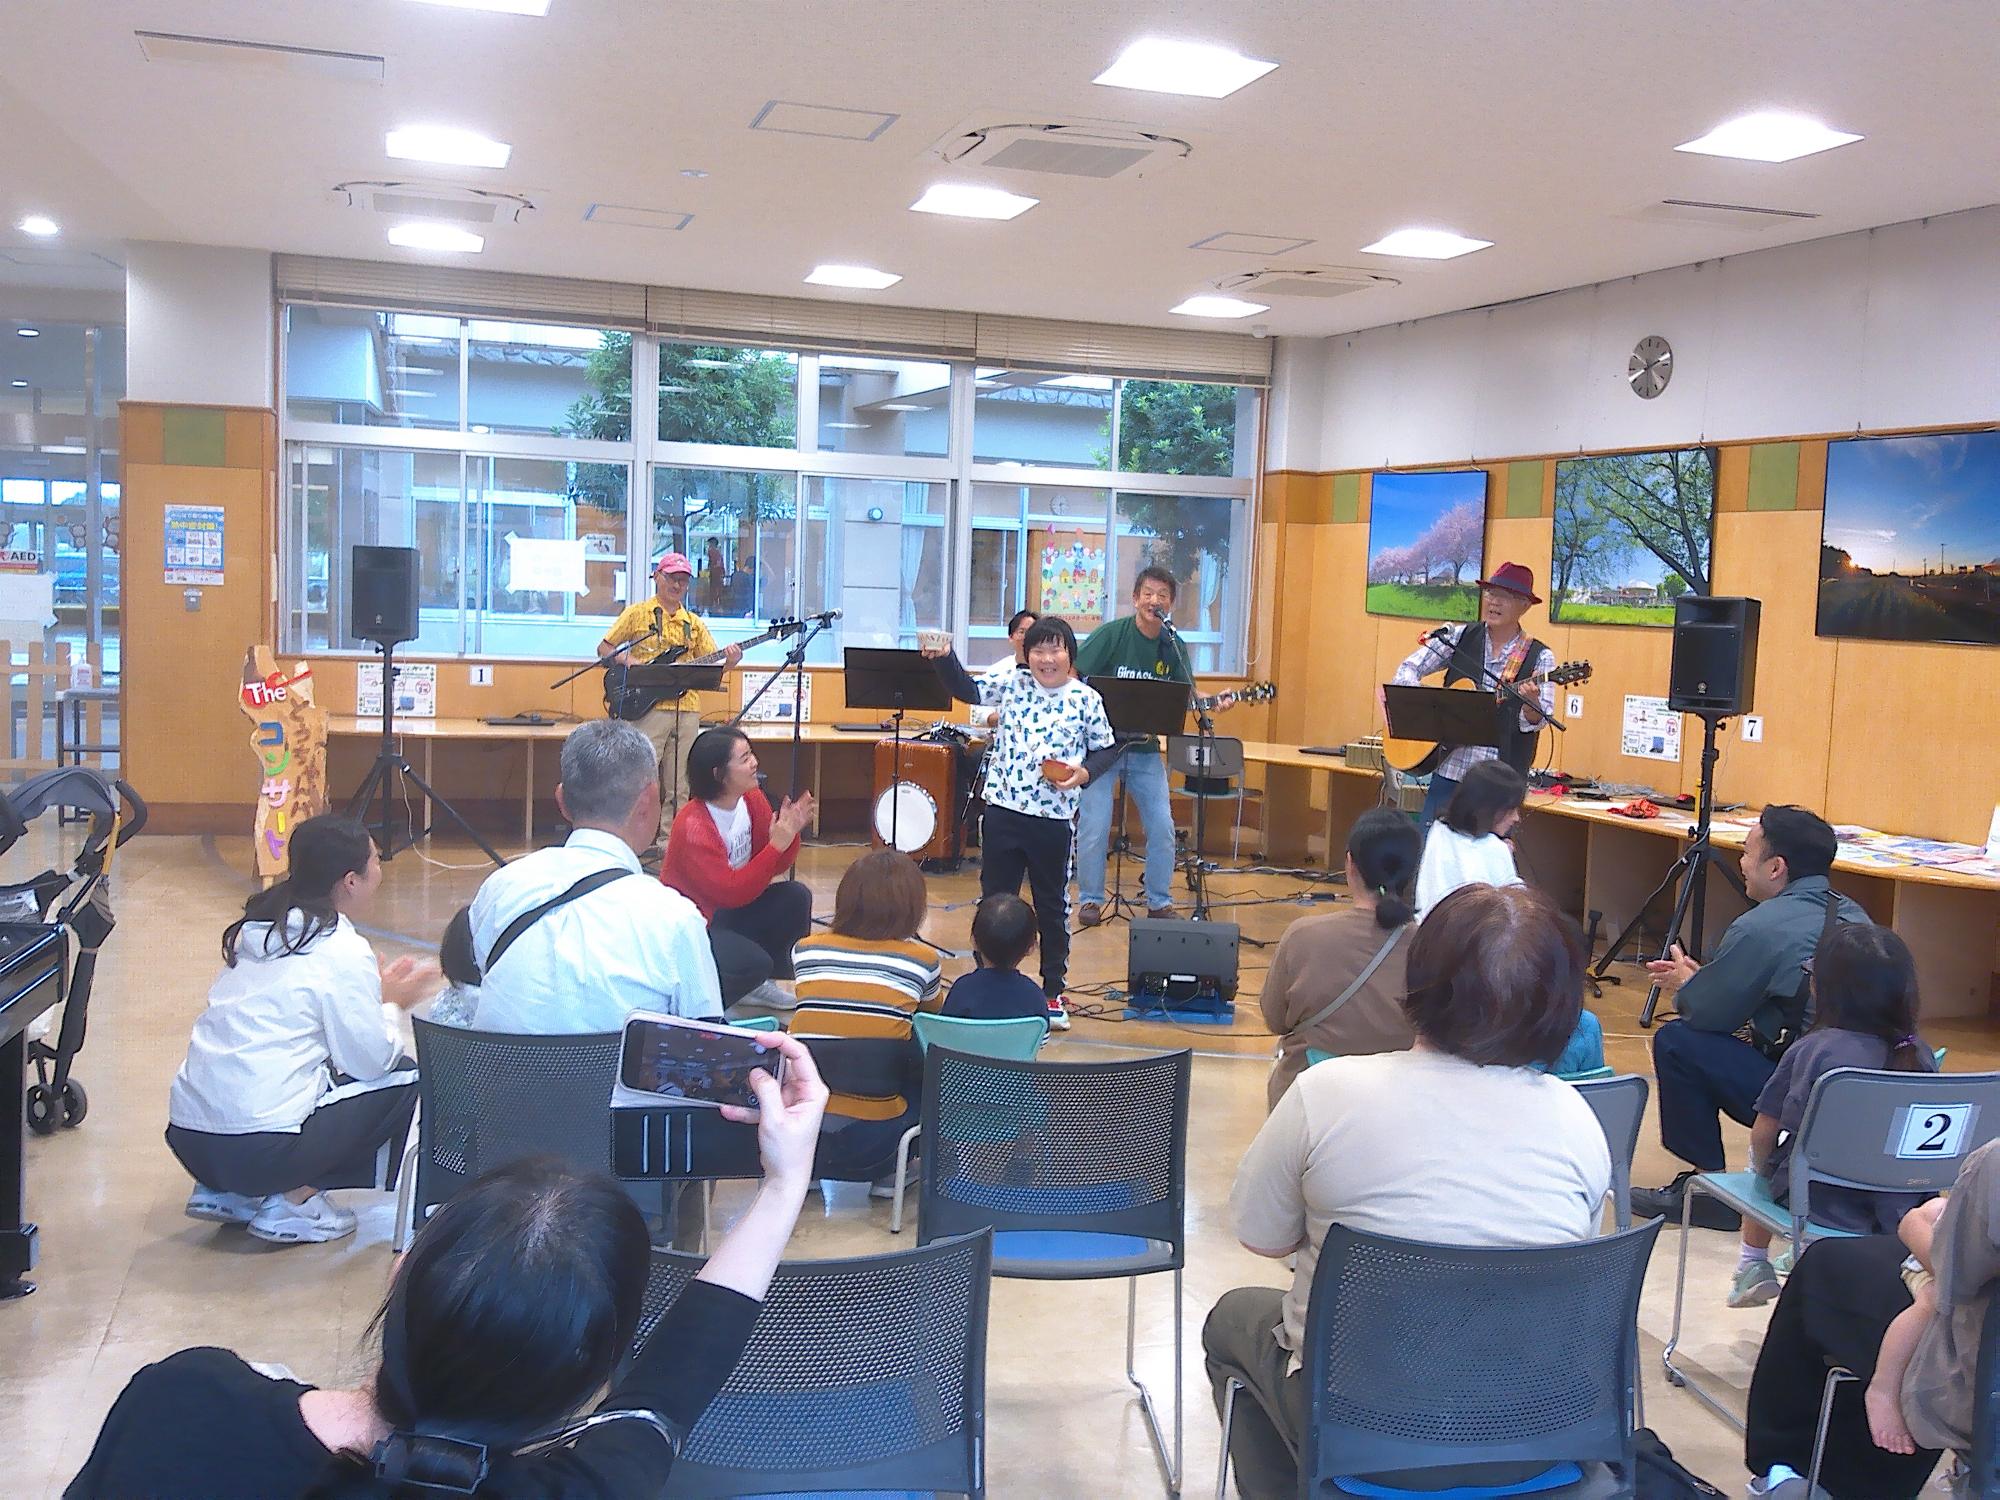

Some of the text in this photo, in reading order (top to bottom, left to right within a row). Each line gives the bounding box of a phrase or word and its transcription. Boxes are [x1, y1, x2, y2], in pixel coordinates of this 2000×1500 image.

[10, 551, 36, 561] AED
[478, 668, 484, 682] 1
[245, 682, 287, 704] The
[1570, 699, 1579, 715] 6
[1747, 719, 1757, 737] 7
[259, 722, 292, 860] コンサート
[1916, 1113, 1951, 1151] 2
